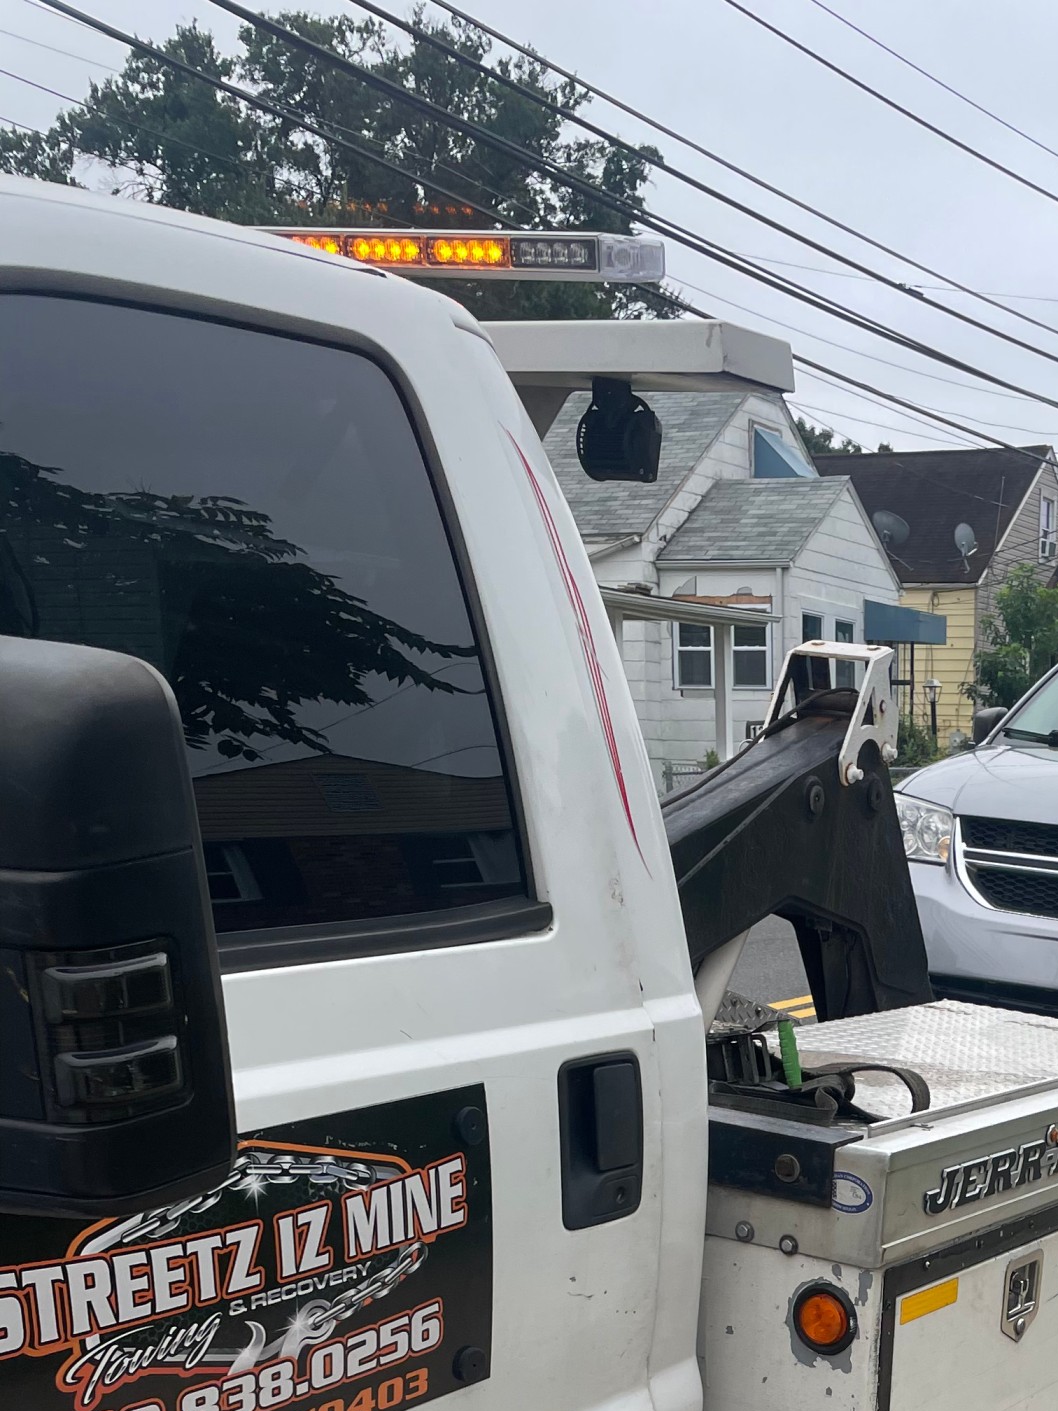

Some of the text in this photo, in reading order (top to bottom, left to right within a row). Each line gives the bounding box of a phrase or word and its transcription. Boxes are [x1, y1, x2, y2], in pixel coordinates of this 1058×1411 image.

[277, 1205, 331, 1278] IZ
[345, 1157, 465, 1257] MINE
[65, 1260, 372, 1405] Towing & RECOVERY
